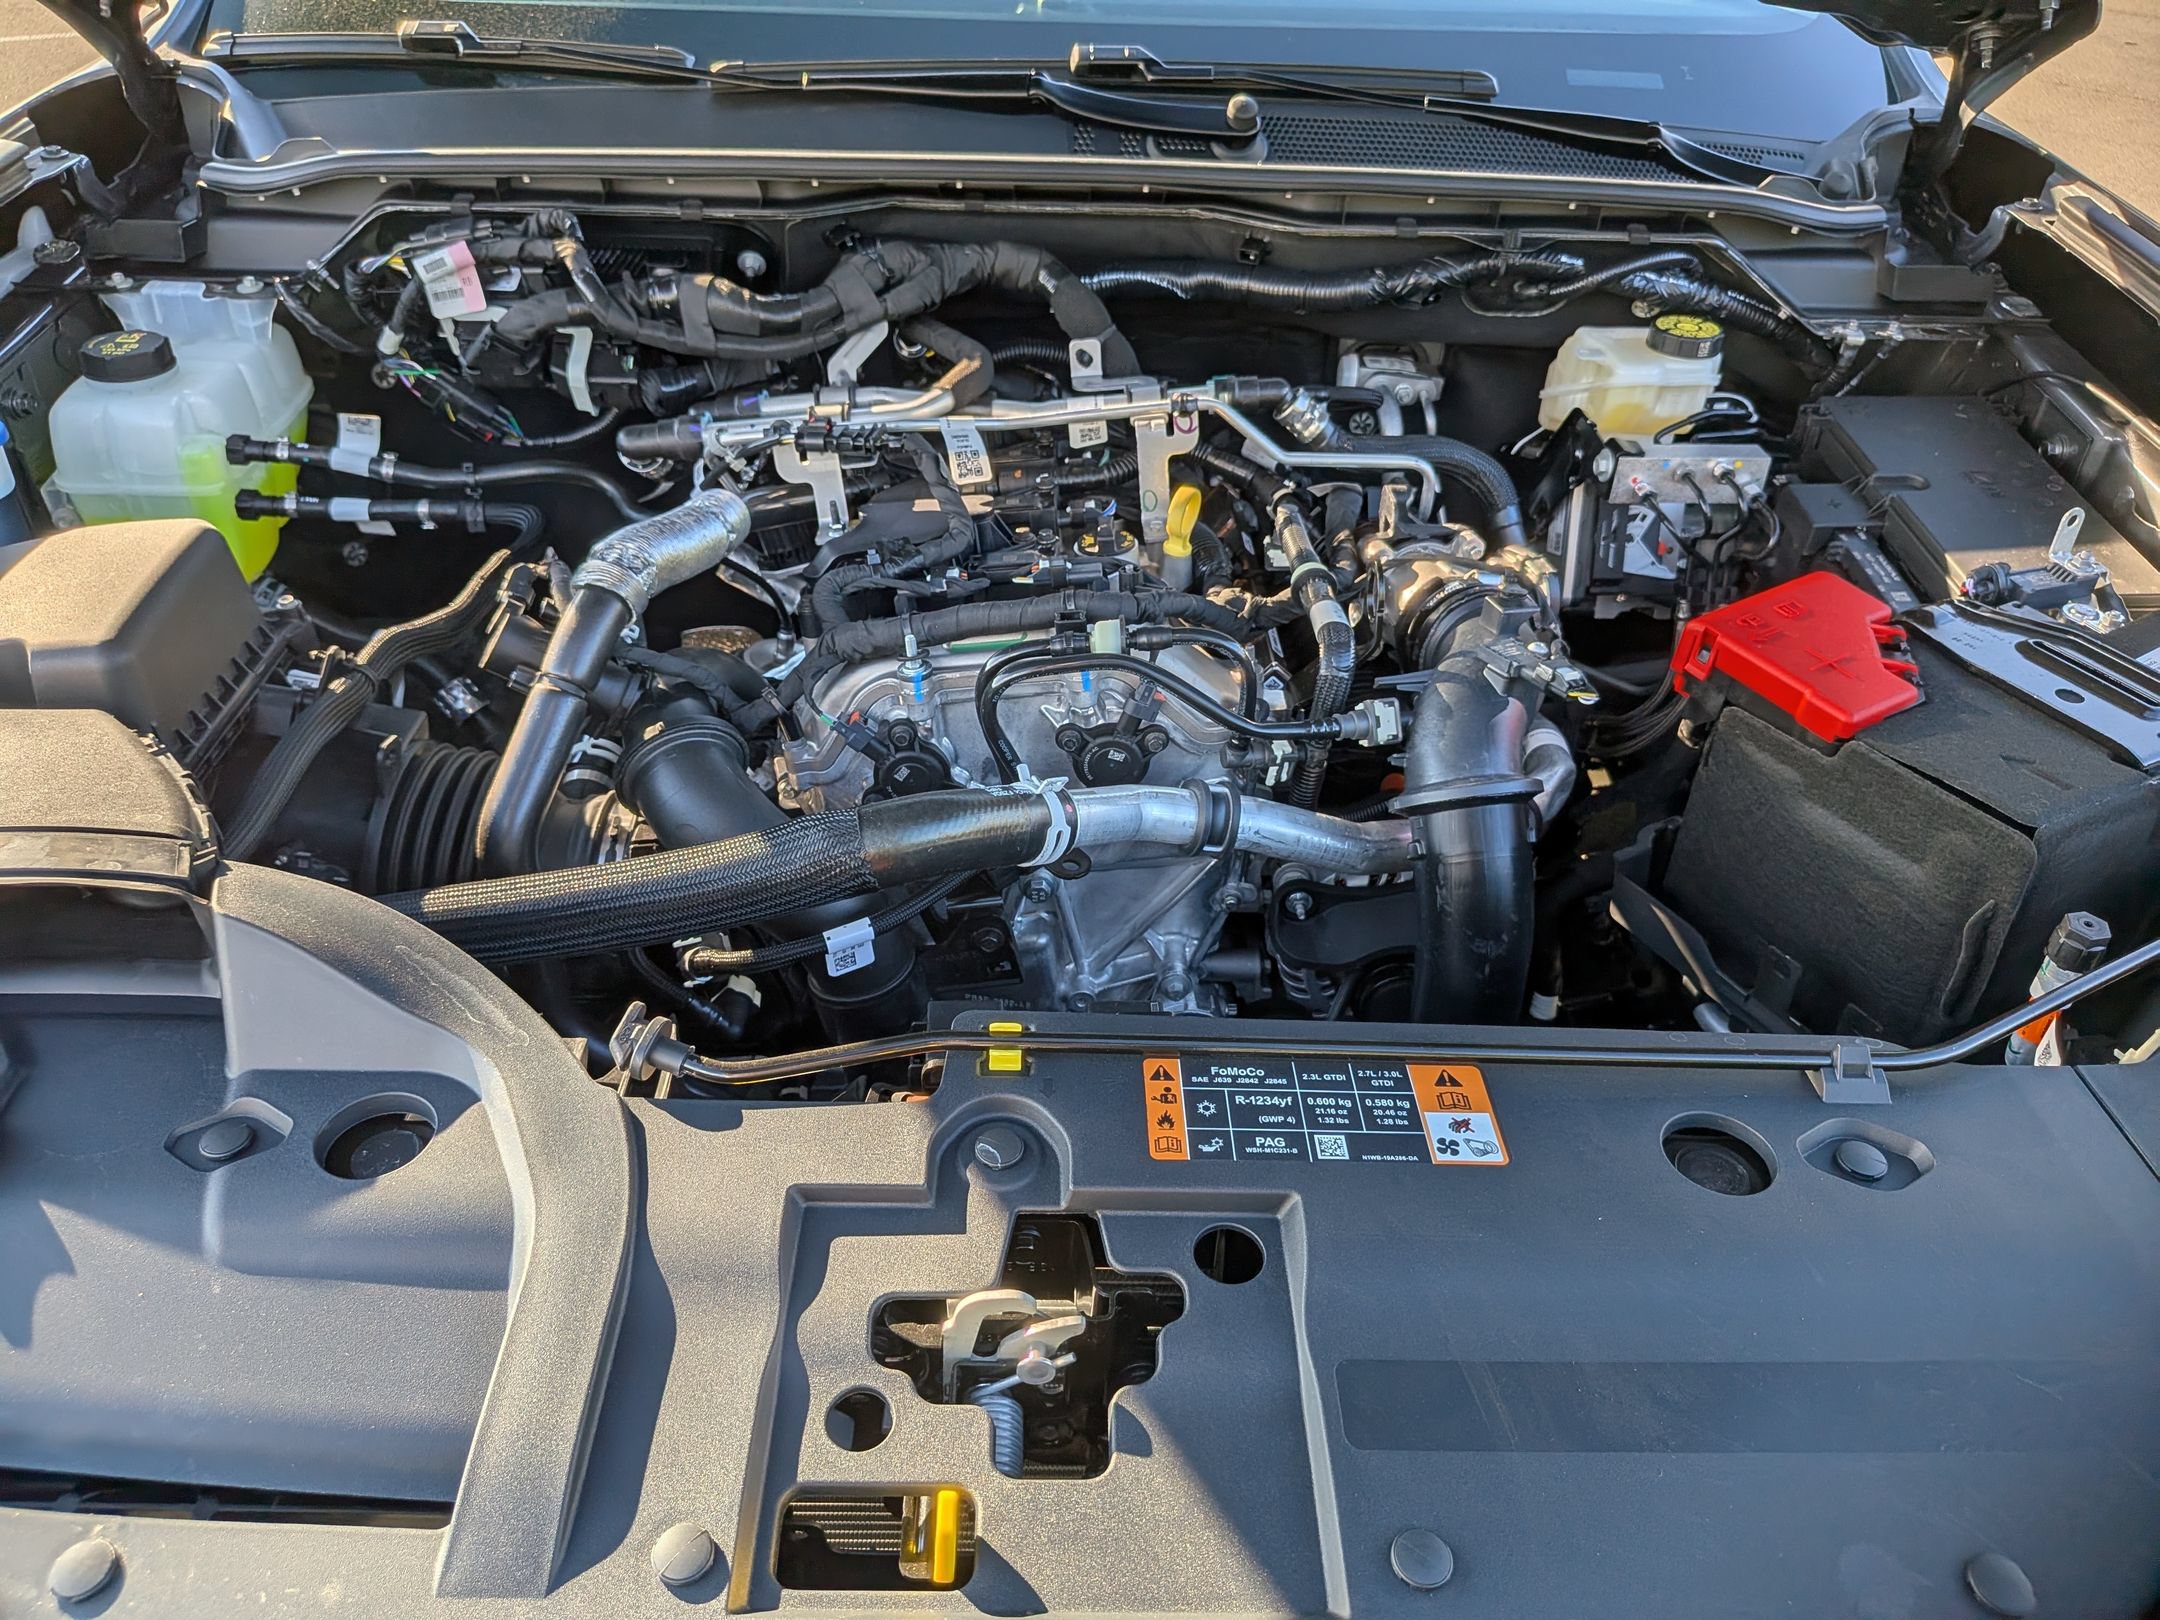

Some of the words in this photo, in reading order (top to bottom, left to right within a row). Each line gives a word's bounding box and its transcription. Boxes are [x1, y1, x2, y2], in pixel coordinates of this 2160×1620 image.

[1210, 1066, 1265, 1076] FoMoCo
[1383, 1070, 1403, 1078] 3.0L
[1235, 1095, 1293, 1108] R-1234yf
[1306, 1097, 1336, 1106] 0.600
[1338, 1097, 1352, 1108] kg
[1365, 1098, 1394, 1107] 0.580
[1396, 1099, 1410, 1109] kg
[1315, 1107, 1336, 1115] 21.16
[1258, 1115, 1285, 1124] (GWP
[1286, 1115, 1296, 1125] 4)
[1255, 1136, 1286, 1147] PAG
